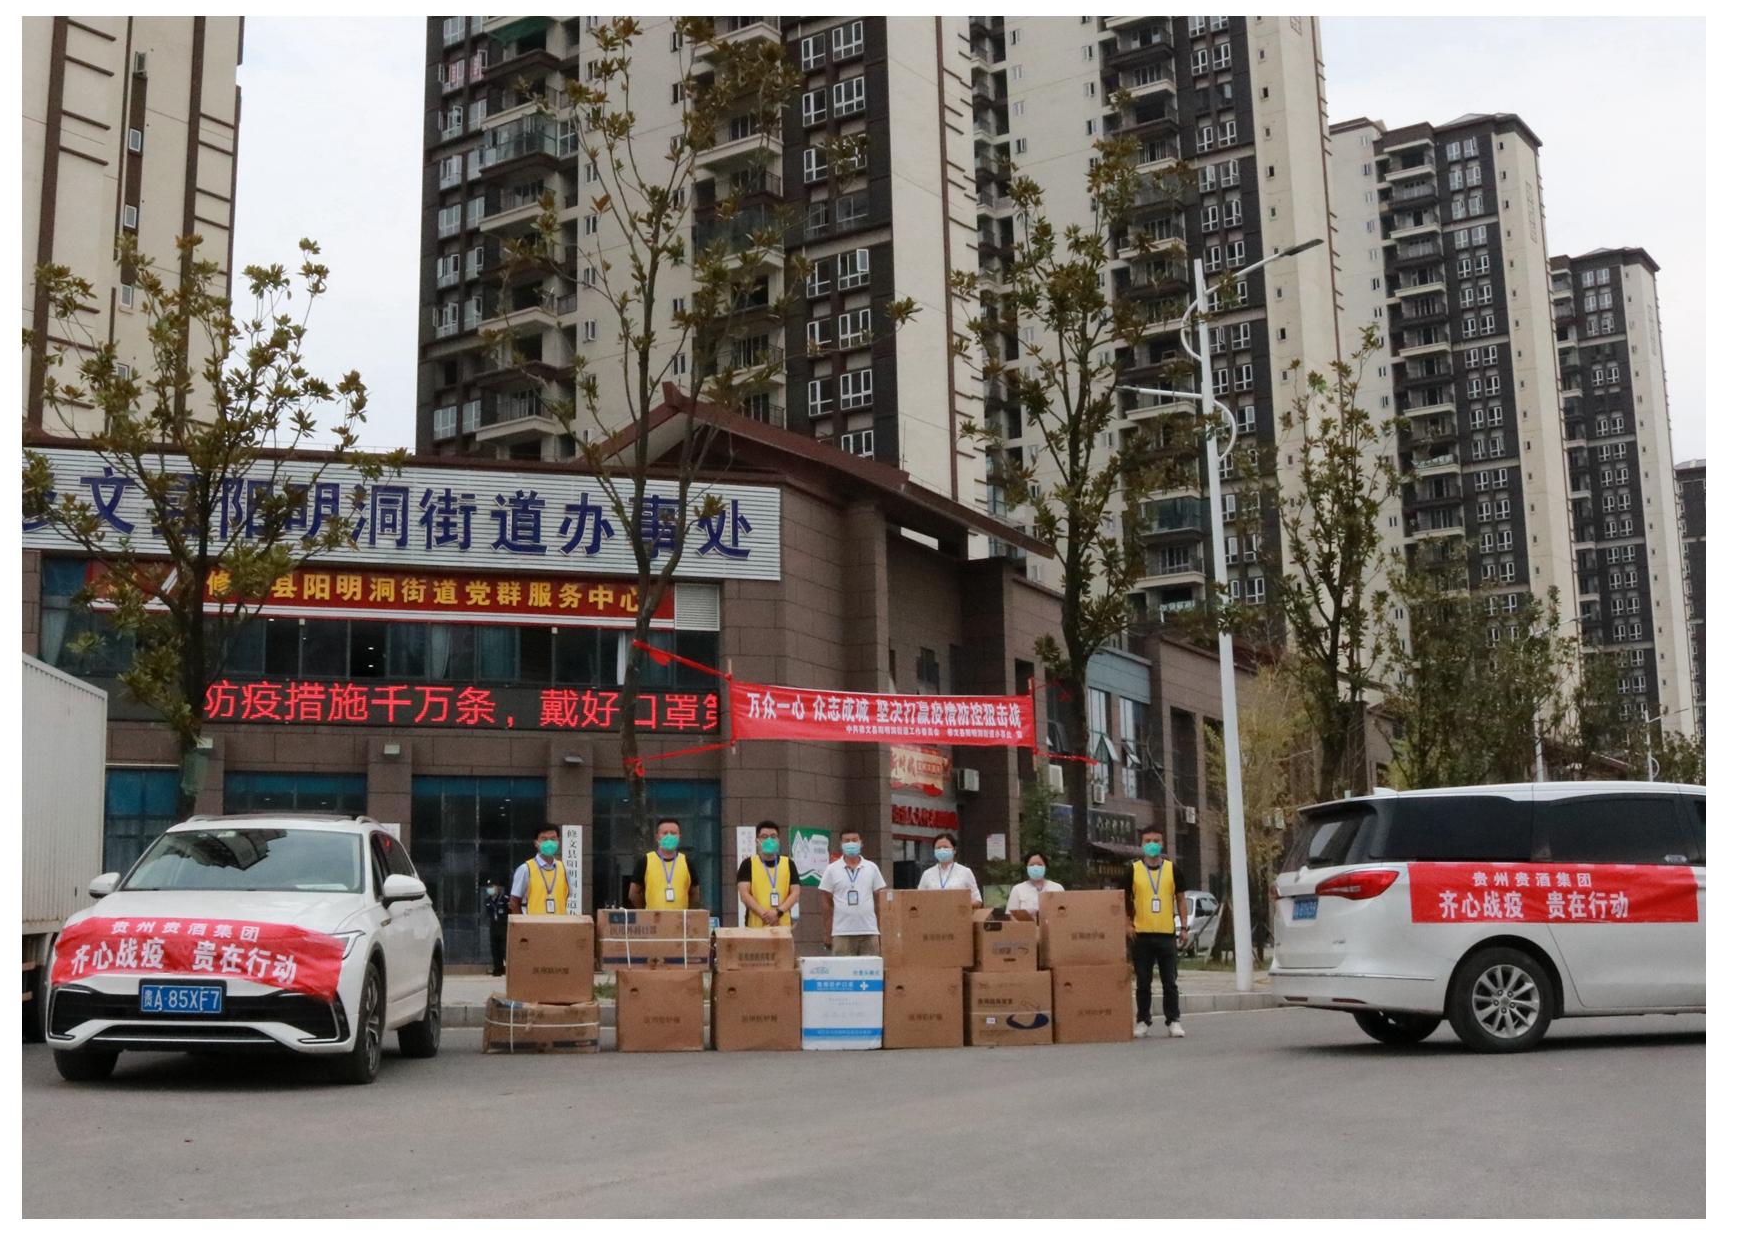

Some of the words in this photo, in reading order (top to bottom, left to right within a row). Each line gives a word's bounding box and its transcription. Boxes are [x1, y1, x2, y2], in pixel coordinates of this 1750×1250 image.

[206, 569, 640, 615] 修县阳明洞街道党群服务中心
[746, 691, 805, 721] 万众一心
[812, 694, 870, 724] 众志成城
[1472, 871, 1594, 888] 贵州贵酒集团
[1438, 890, 1525, 919] 齐心战疫
[1546, 890, 1630, 919] 贵在行动
[110, 920, 262, 943] 贵州贵酒集团
[71, 937, 166, 976] 齐心战疫
[192, 939, 299, 985] 贵在行动
